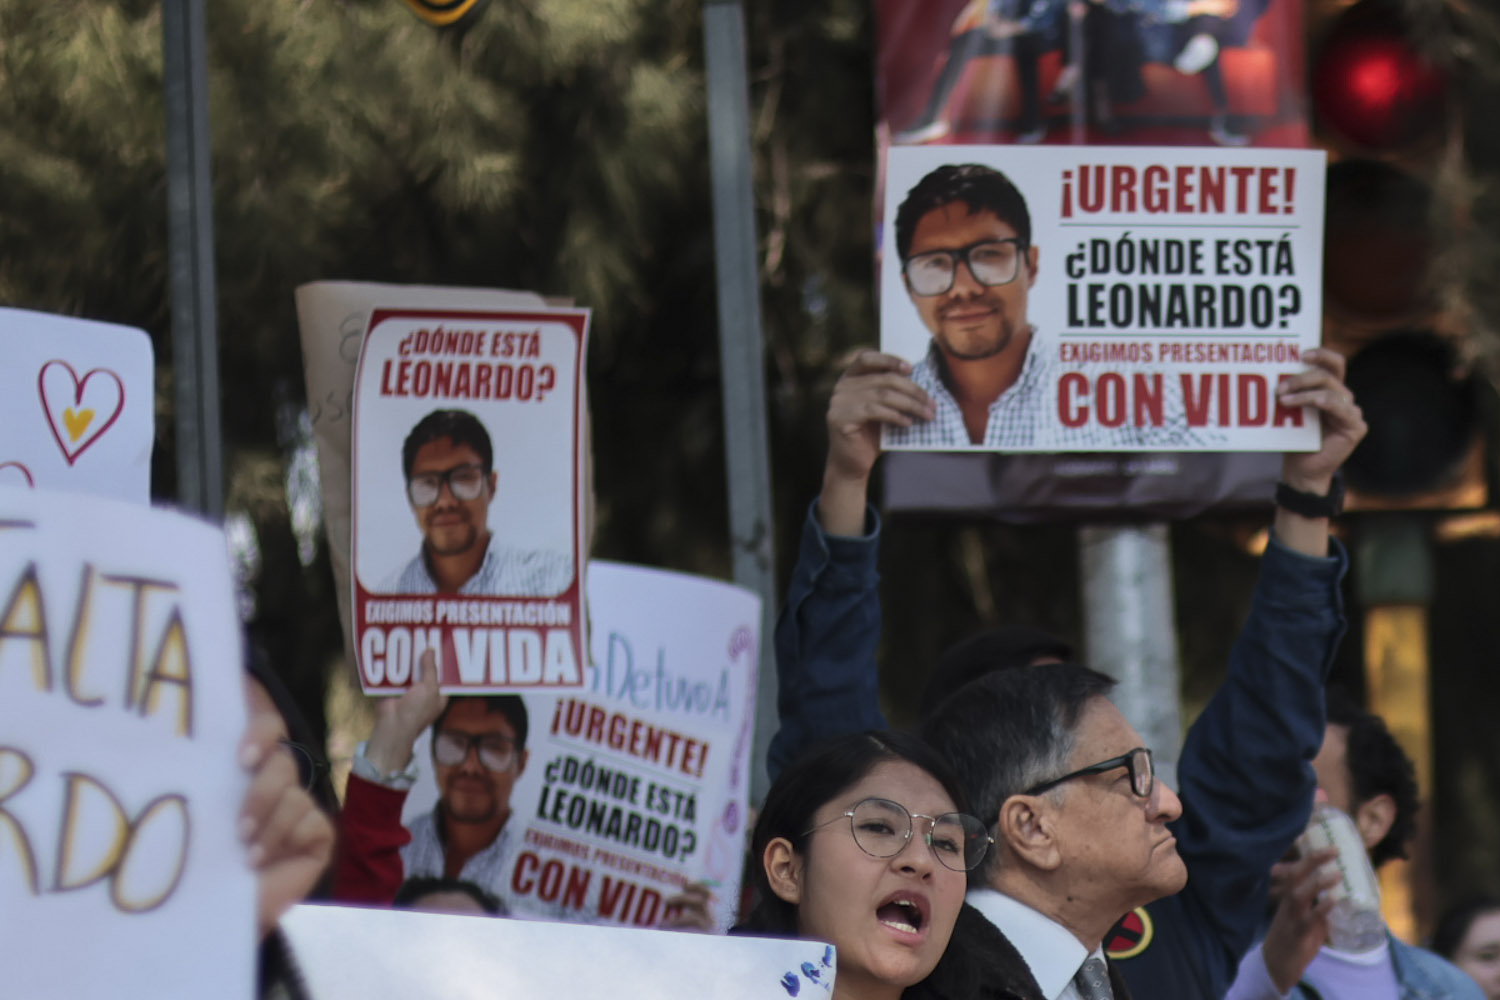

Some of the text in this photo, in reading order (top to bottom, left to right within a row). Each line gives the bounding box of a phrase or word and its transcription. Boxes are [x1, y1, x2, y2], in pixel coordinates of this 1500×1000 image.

[1060, 165, 1297, 218] ¡URGENTE!
[1065, 231, 1296, 279] ¿DÓNDE ESTÁ
[1067, 283, 1302, 328] LEONARDO?
[398, 325, 485, 358] ¿DÓNDE
[490, 328, 542, 358] ESTÁ
[1060, 341, 1301, 363] EXIGIMOS PRESENTACIÓN
[379, 359, 556, 401] LEONARDO?
[1057, 371, 1164, 428] CON
[0, 519, 194, 740] ALTA
[365, 599, 572, 626] EXIGIMOS PRESENTACIÓN
[361, 626, 442, 686] CON
[452, 627, 580, 685] VIDA
[552, 699, 710, 778] ¡URGENTE!
[544, 754, 698, 825] ¿DÓNDE ESTÁ
[537, 786, 698, 862] LEONARDO?
[511, 851, 592, 911] CON
